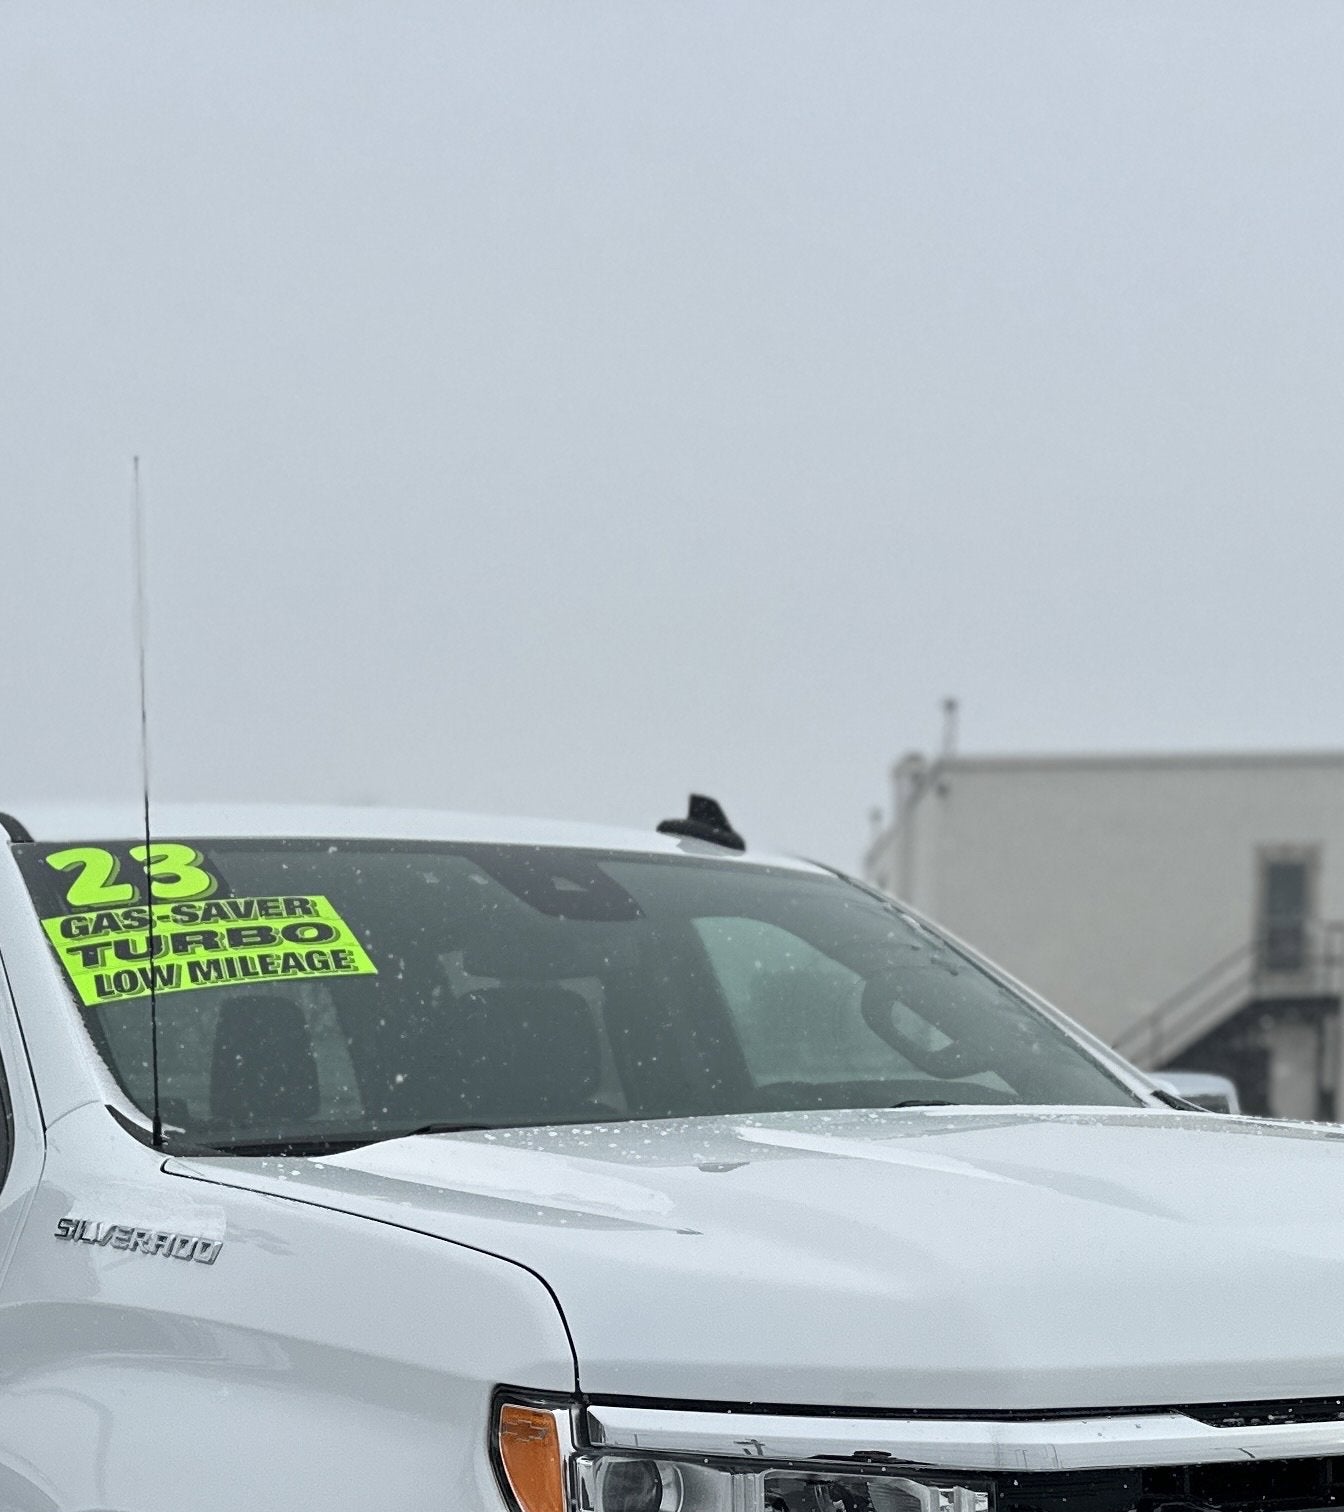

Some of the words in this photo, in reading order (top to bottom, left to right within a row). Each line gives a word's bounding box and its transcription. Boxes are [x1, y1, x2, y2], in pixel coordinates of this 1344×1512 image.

[46, 843, 216, 908] 23
[60, 897, 320, 940] GAS-SAVER
[66, 921, 340, 969] TURBO
[94, 963, 183, 999] LOW
[187, 948, 359, 985] MILEAGE
[54, 1218, 224, 1265] SILVERADO
